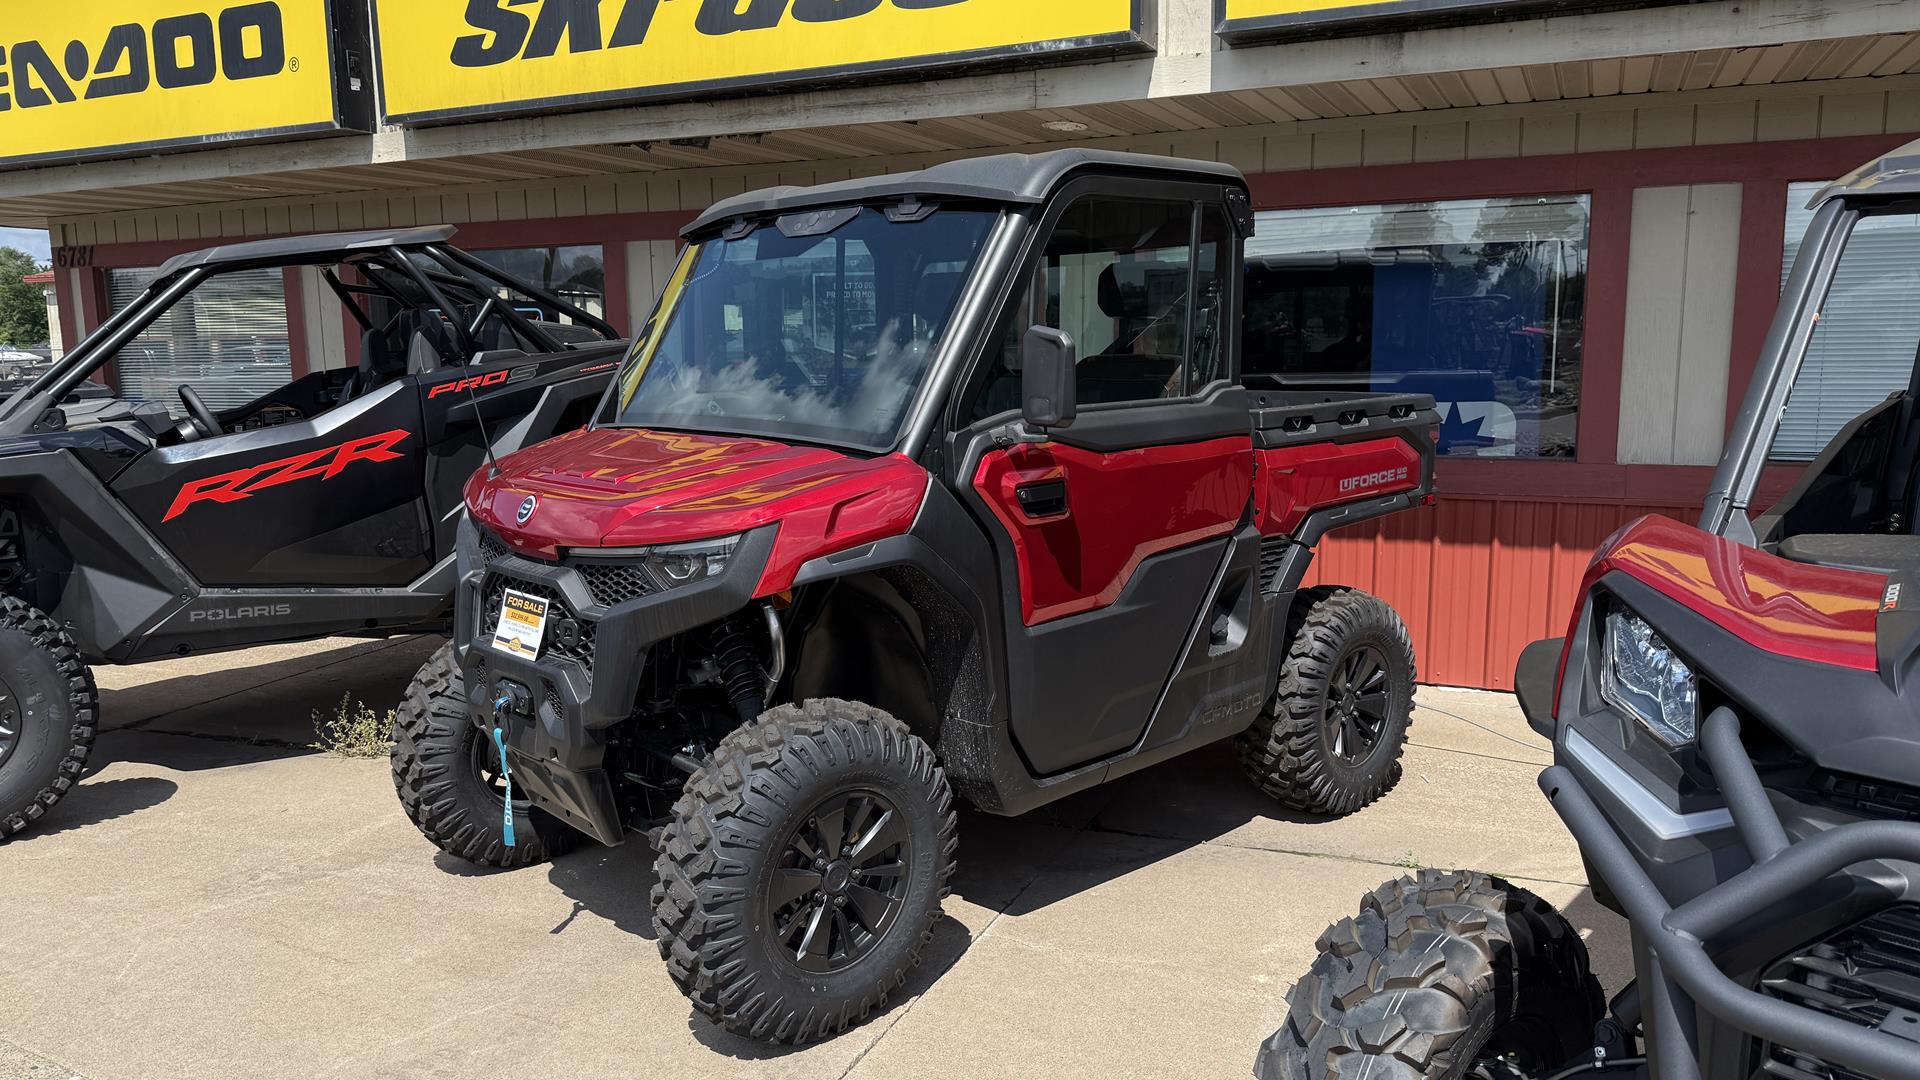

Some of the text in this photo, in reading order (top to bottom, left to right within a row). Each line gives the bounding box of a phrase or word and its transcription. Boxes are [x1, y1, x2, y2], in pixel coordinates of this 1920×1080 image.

[57, 245, 94, 268] 6781
[161, 428, 411, 523] RZR
[190, 603, 291, 622] POLARIS
[507, 596, 544, 614] FOR SALE
